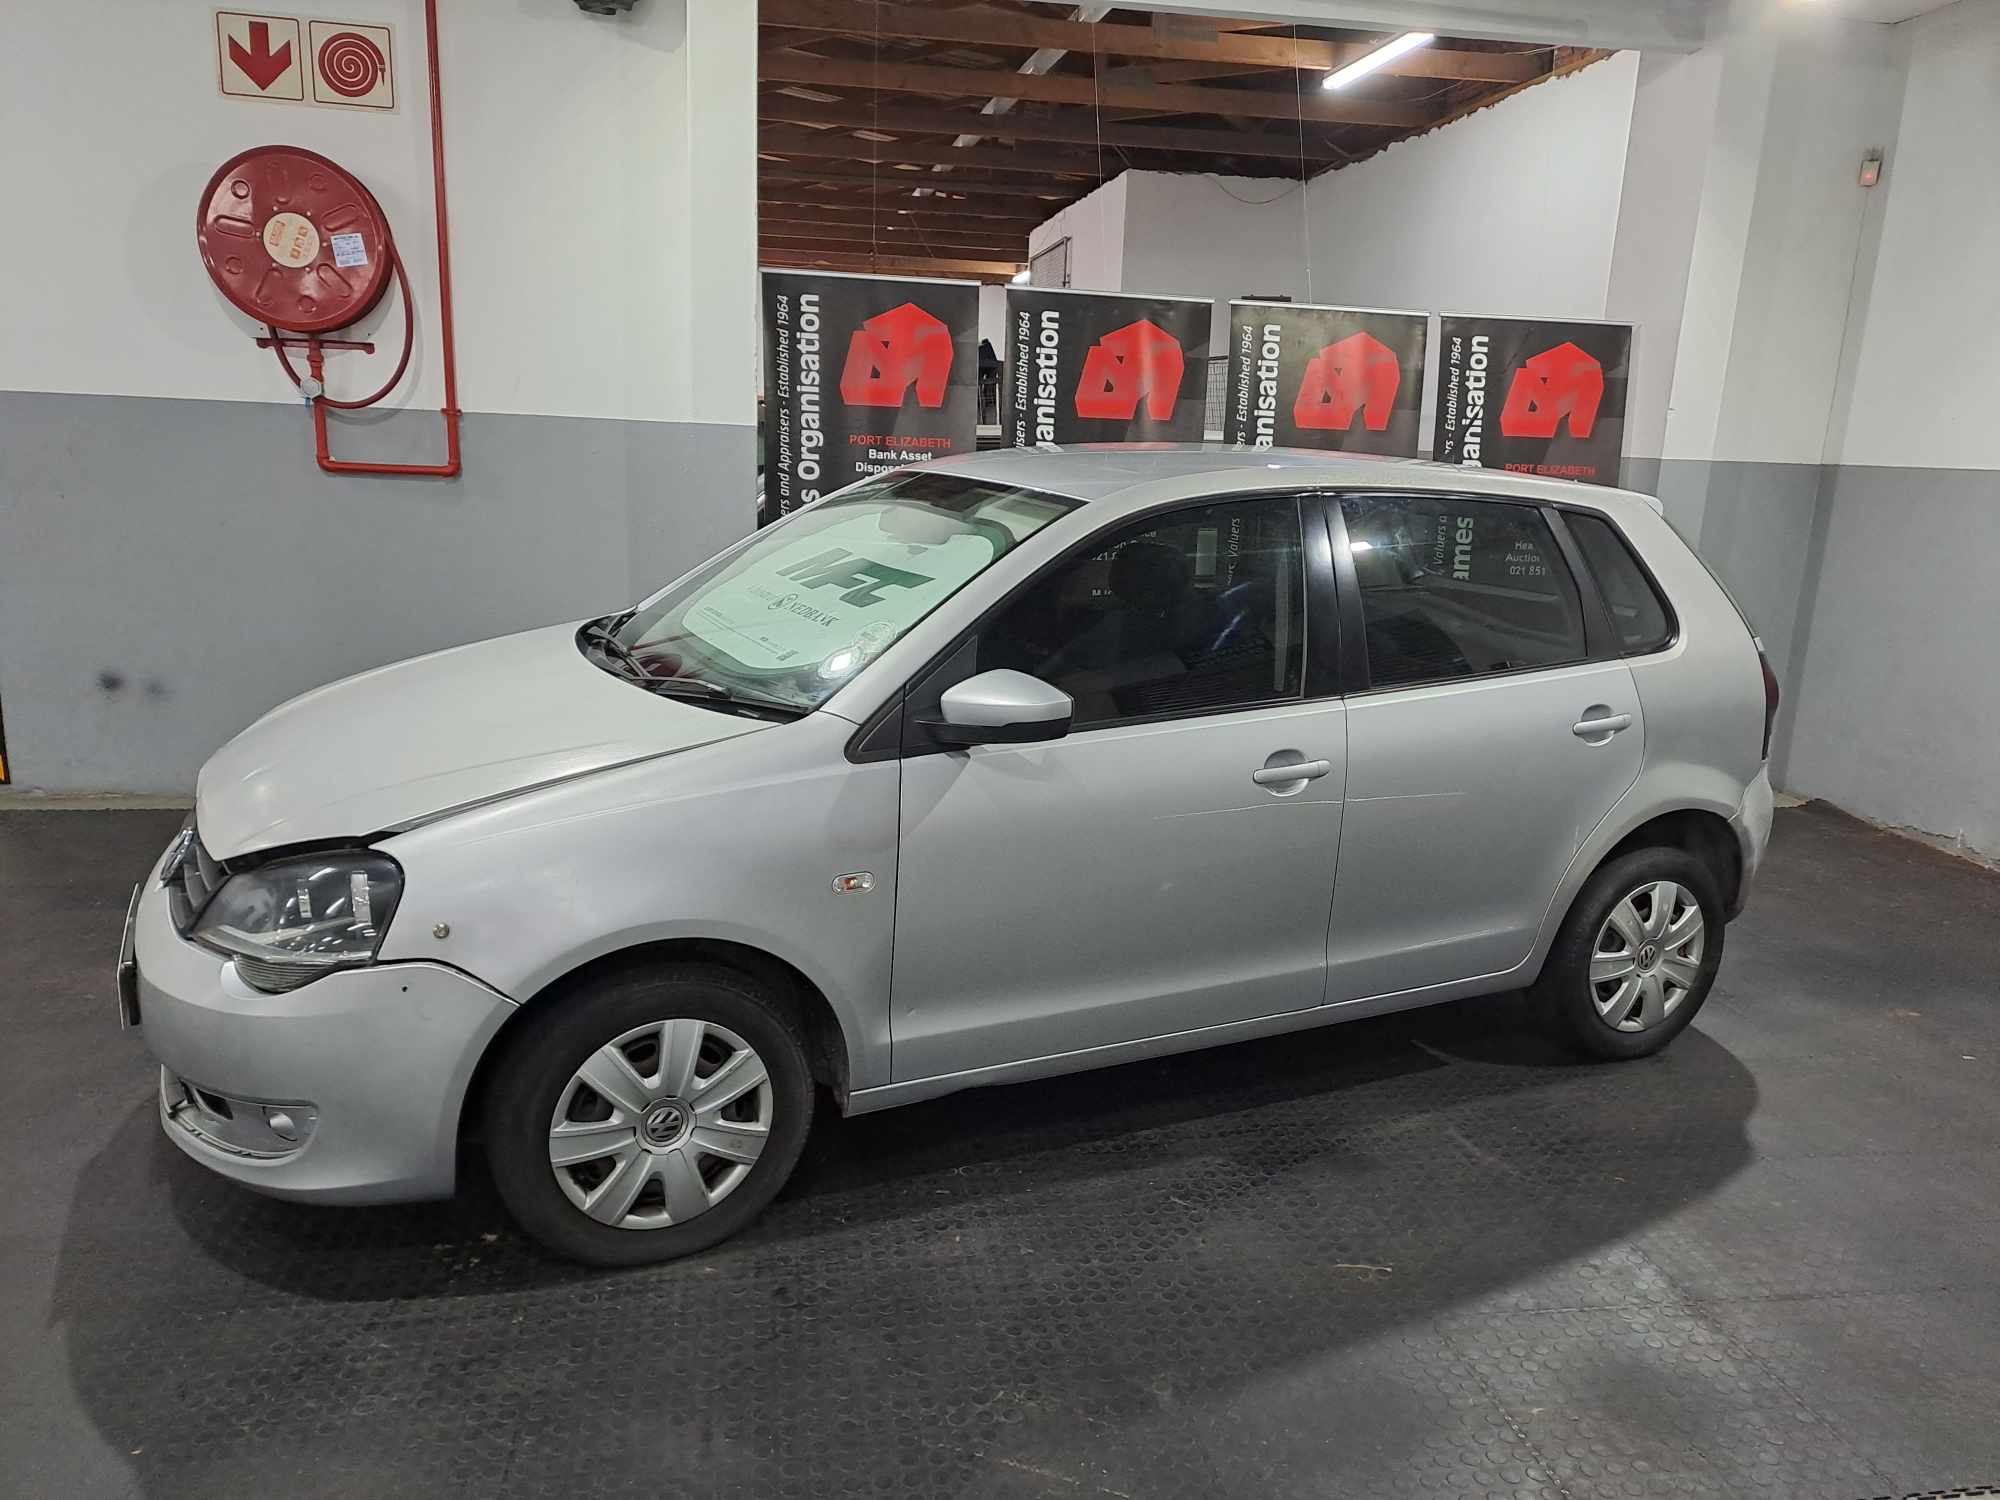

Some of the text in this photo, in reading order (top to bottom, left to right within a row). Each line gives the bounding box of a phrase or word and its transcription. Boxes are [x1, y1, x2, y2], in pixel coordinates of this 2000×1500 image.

[776, 294, 789, 325] 1964
[1018, 311, 1031, 341] 1964
[1241, 325, 1254, 353] 1964
[776, 328, 790, 399] Established
[1450, 336, 1463, 365] 1964
[796, 293, 824, 481] Organisation
[1015, 343, 1030, 411] Established
[1236, 356, 1251, 422] Established
[1445, 366, 1460, 431] Established
[778, 408, 792, 472] Appraisers
[849, 434, 951, 449] PORT ELIZABETH
[868, 448, 932, 462] Bank Asset
[777, 472, 790, 497] and
[1504, 463, 1596, 478] PORT ELIZABETH
